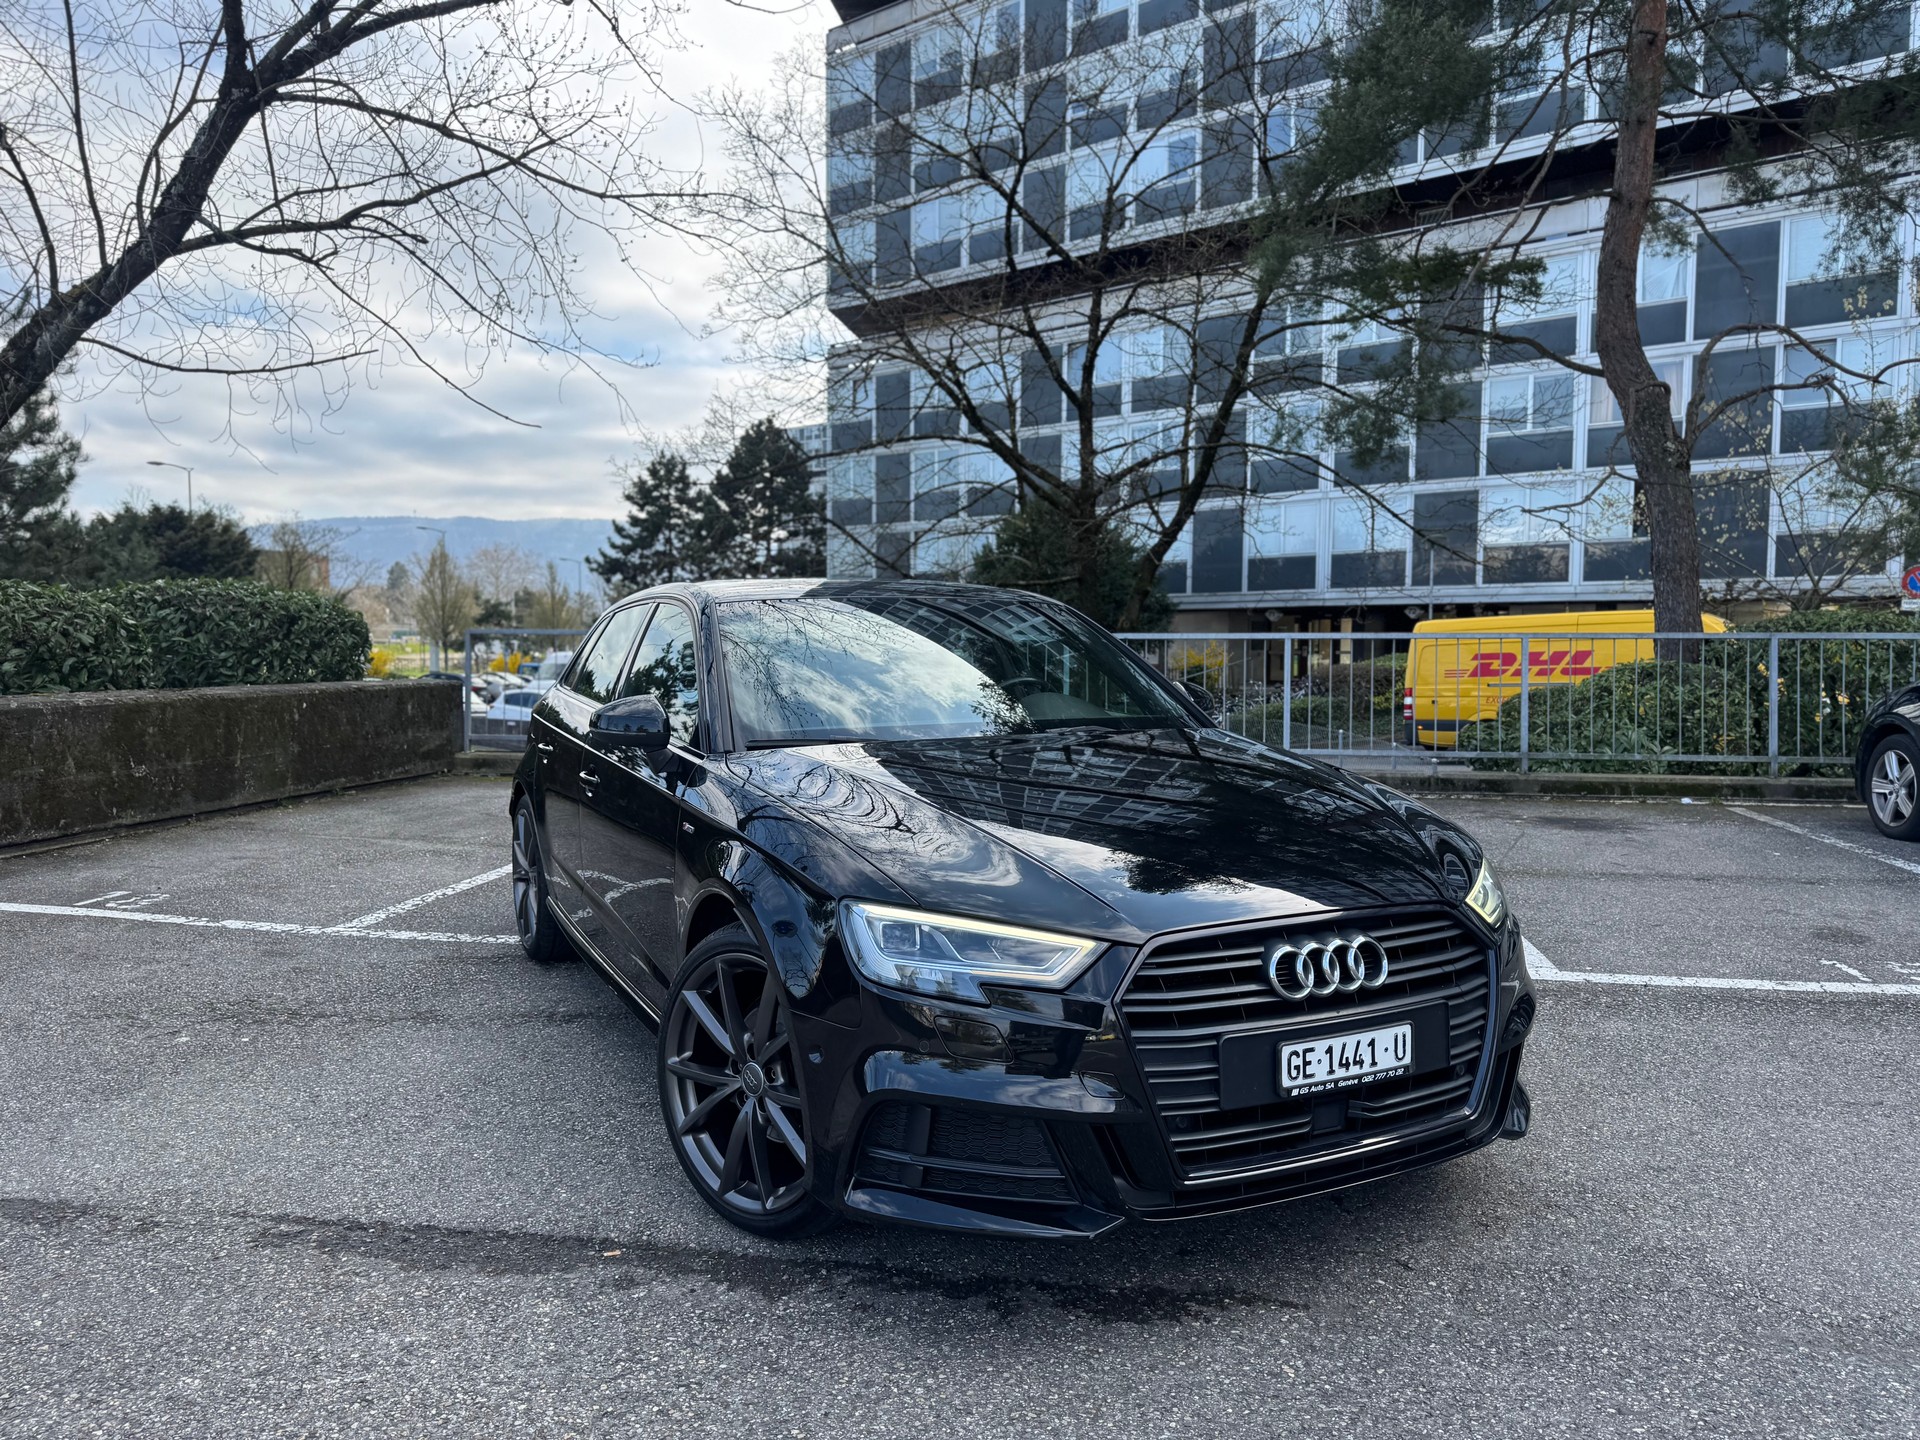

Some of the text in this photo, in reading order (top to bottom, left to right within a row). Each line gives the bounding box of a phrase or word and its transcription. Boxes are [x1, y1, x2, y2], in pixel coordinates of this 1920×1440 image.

[1467, 650, 1602, 677] DHL
[1300, 1086, 1310, 1094] GS
[1310, 1084, 1325, 1093] Auto
[1325, 1082, 1335, 1090] SA
[1361, 1074, 1375, 1083] 022
[1375, 1072, 1387, 1080] 777
[1387, 1070, 1396, 1078] 70
[1395, 1068, 1405, 1076] 22
